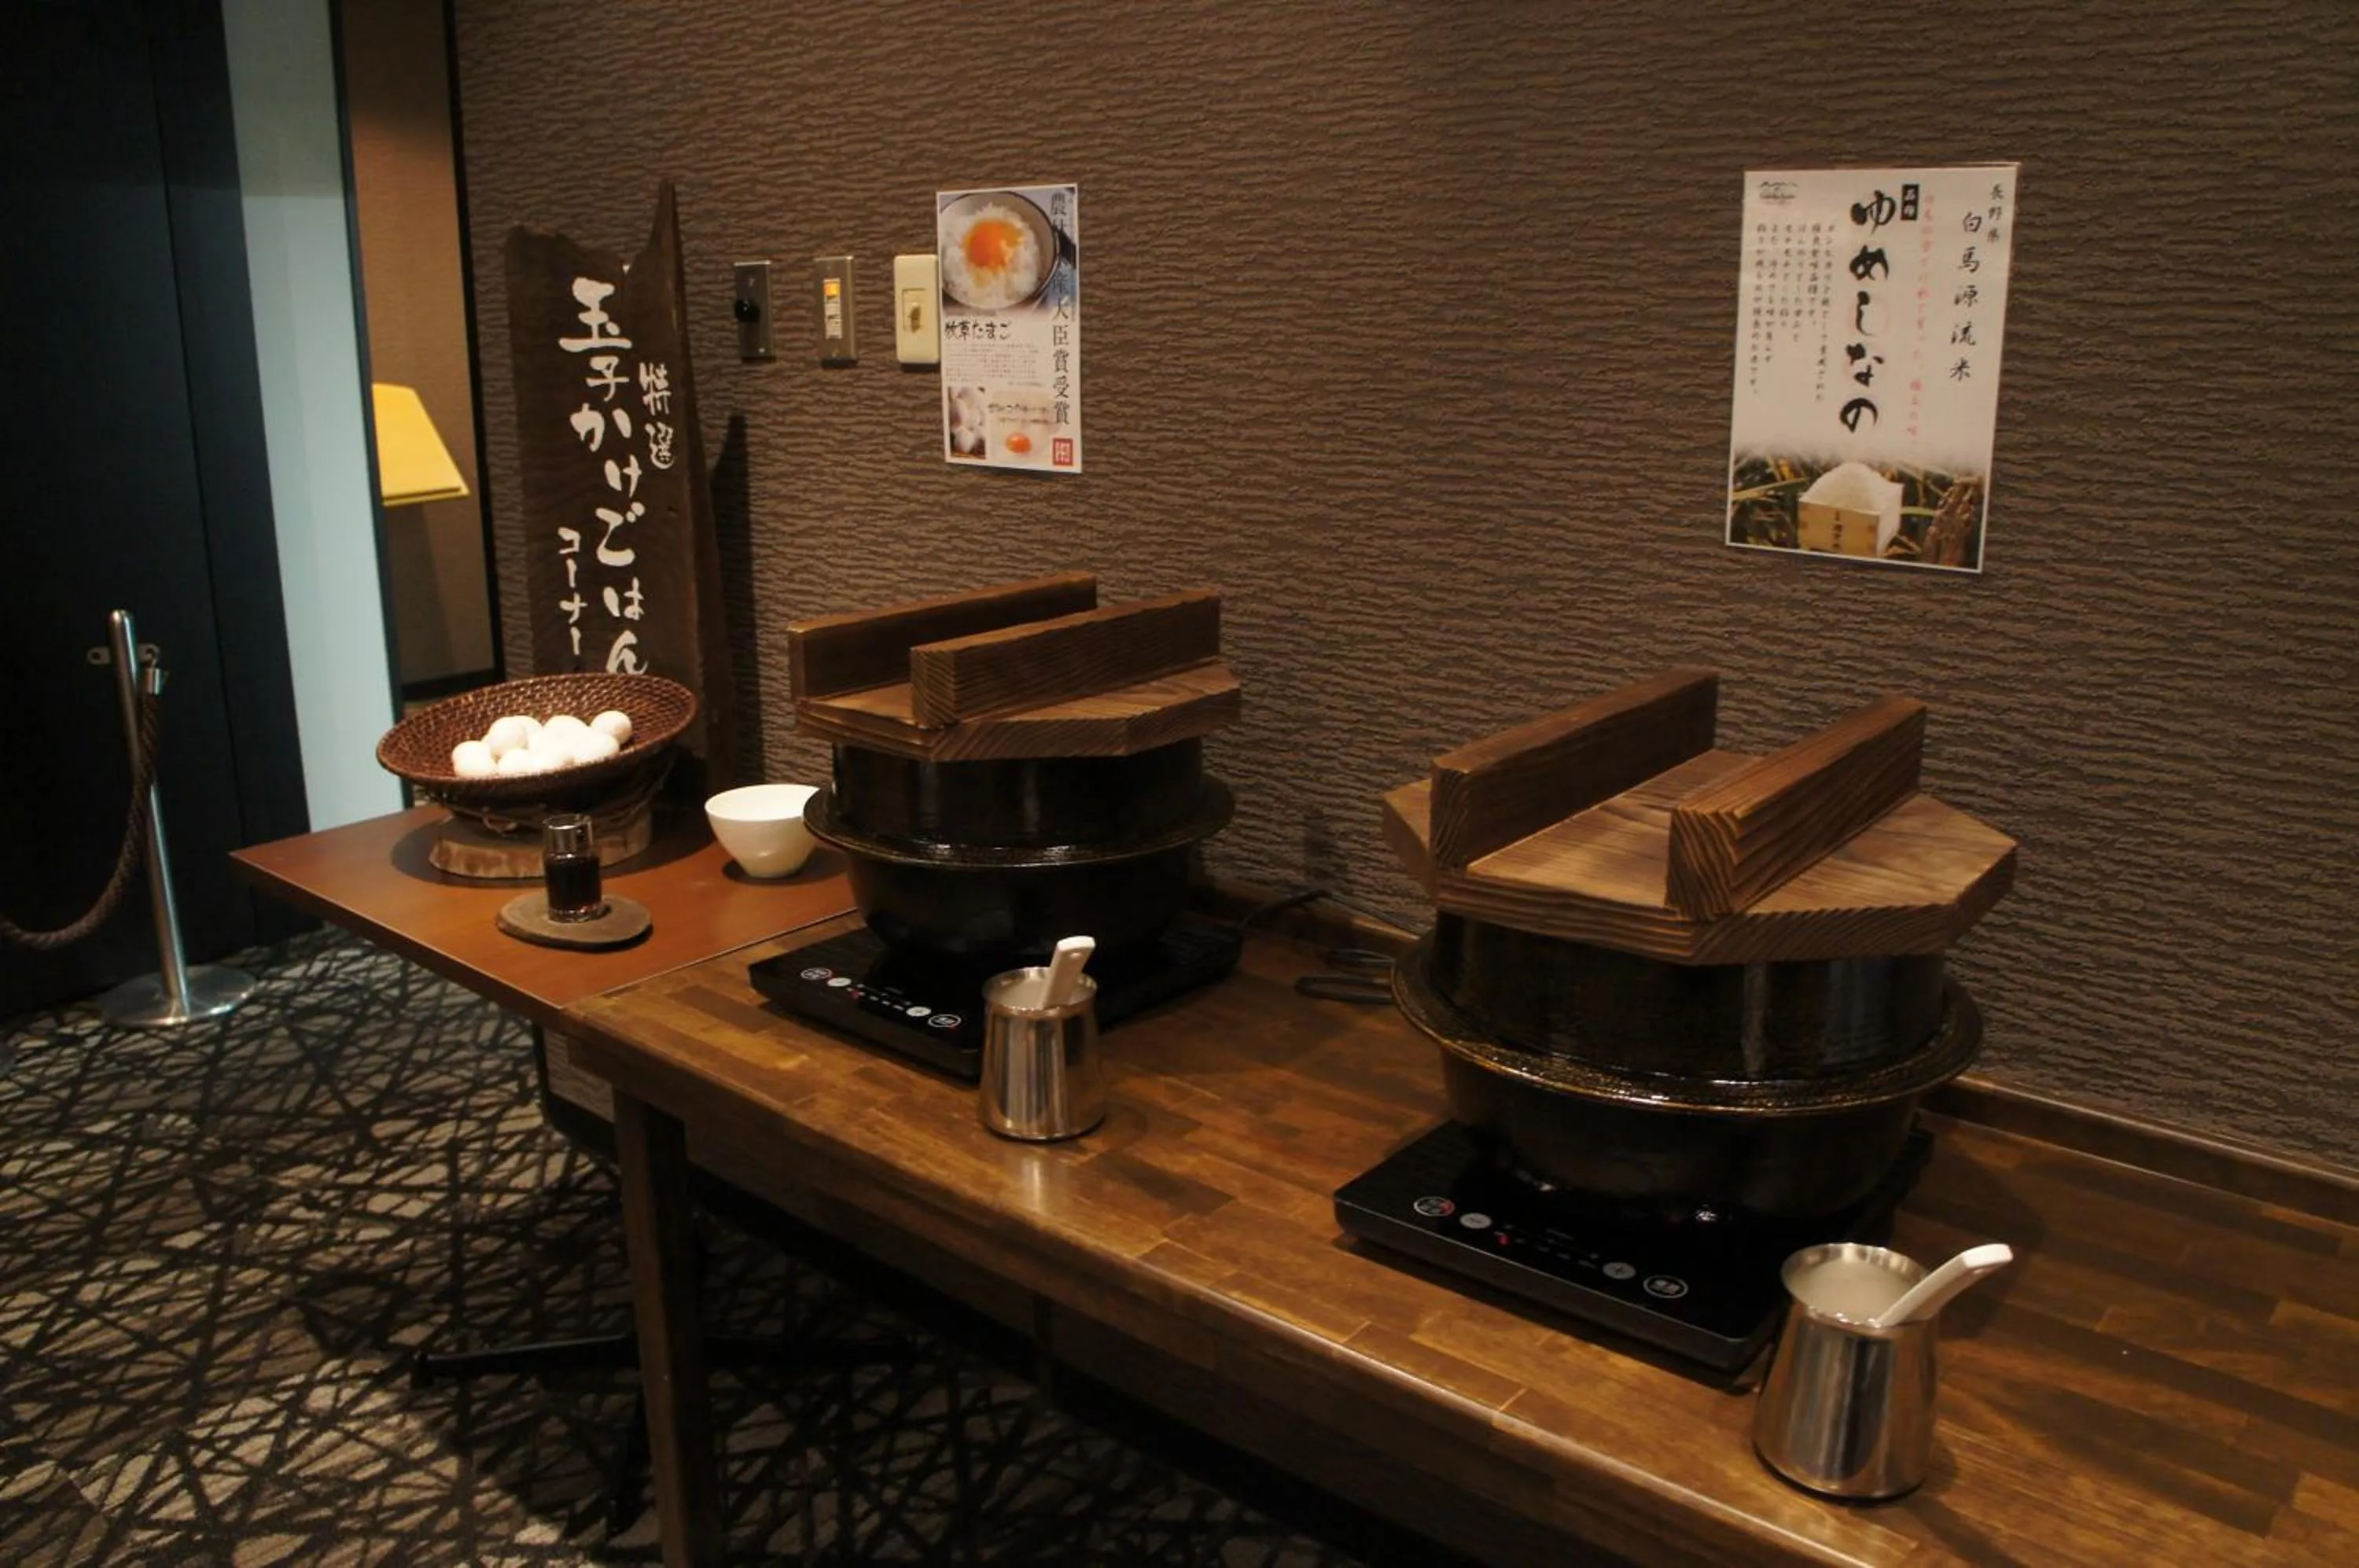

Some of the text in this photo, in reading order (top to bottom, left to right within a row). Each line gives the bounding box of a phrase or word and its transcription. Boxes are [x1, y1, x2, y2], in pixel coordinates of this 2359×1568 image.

[1949, 212, 1982, 382] 白馬源流米
[1987, 183, 2004, 244] 長野県
[1839, 190, 1897, 433] ゆめしなの
[558, 276, 648, 675] 玉子かけごはん
[557, 526, 589, 657] コーナー
